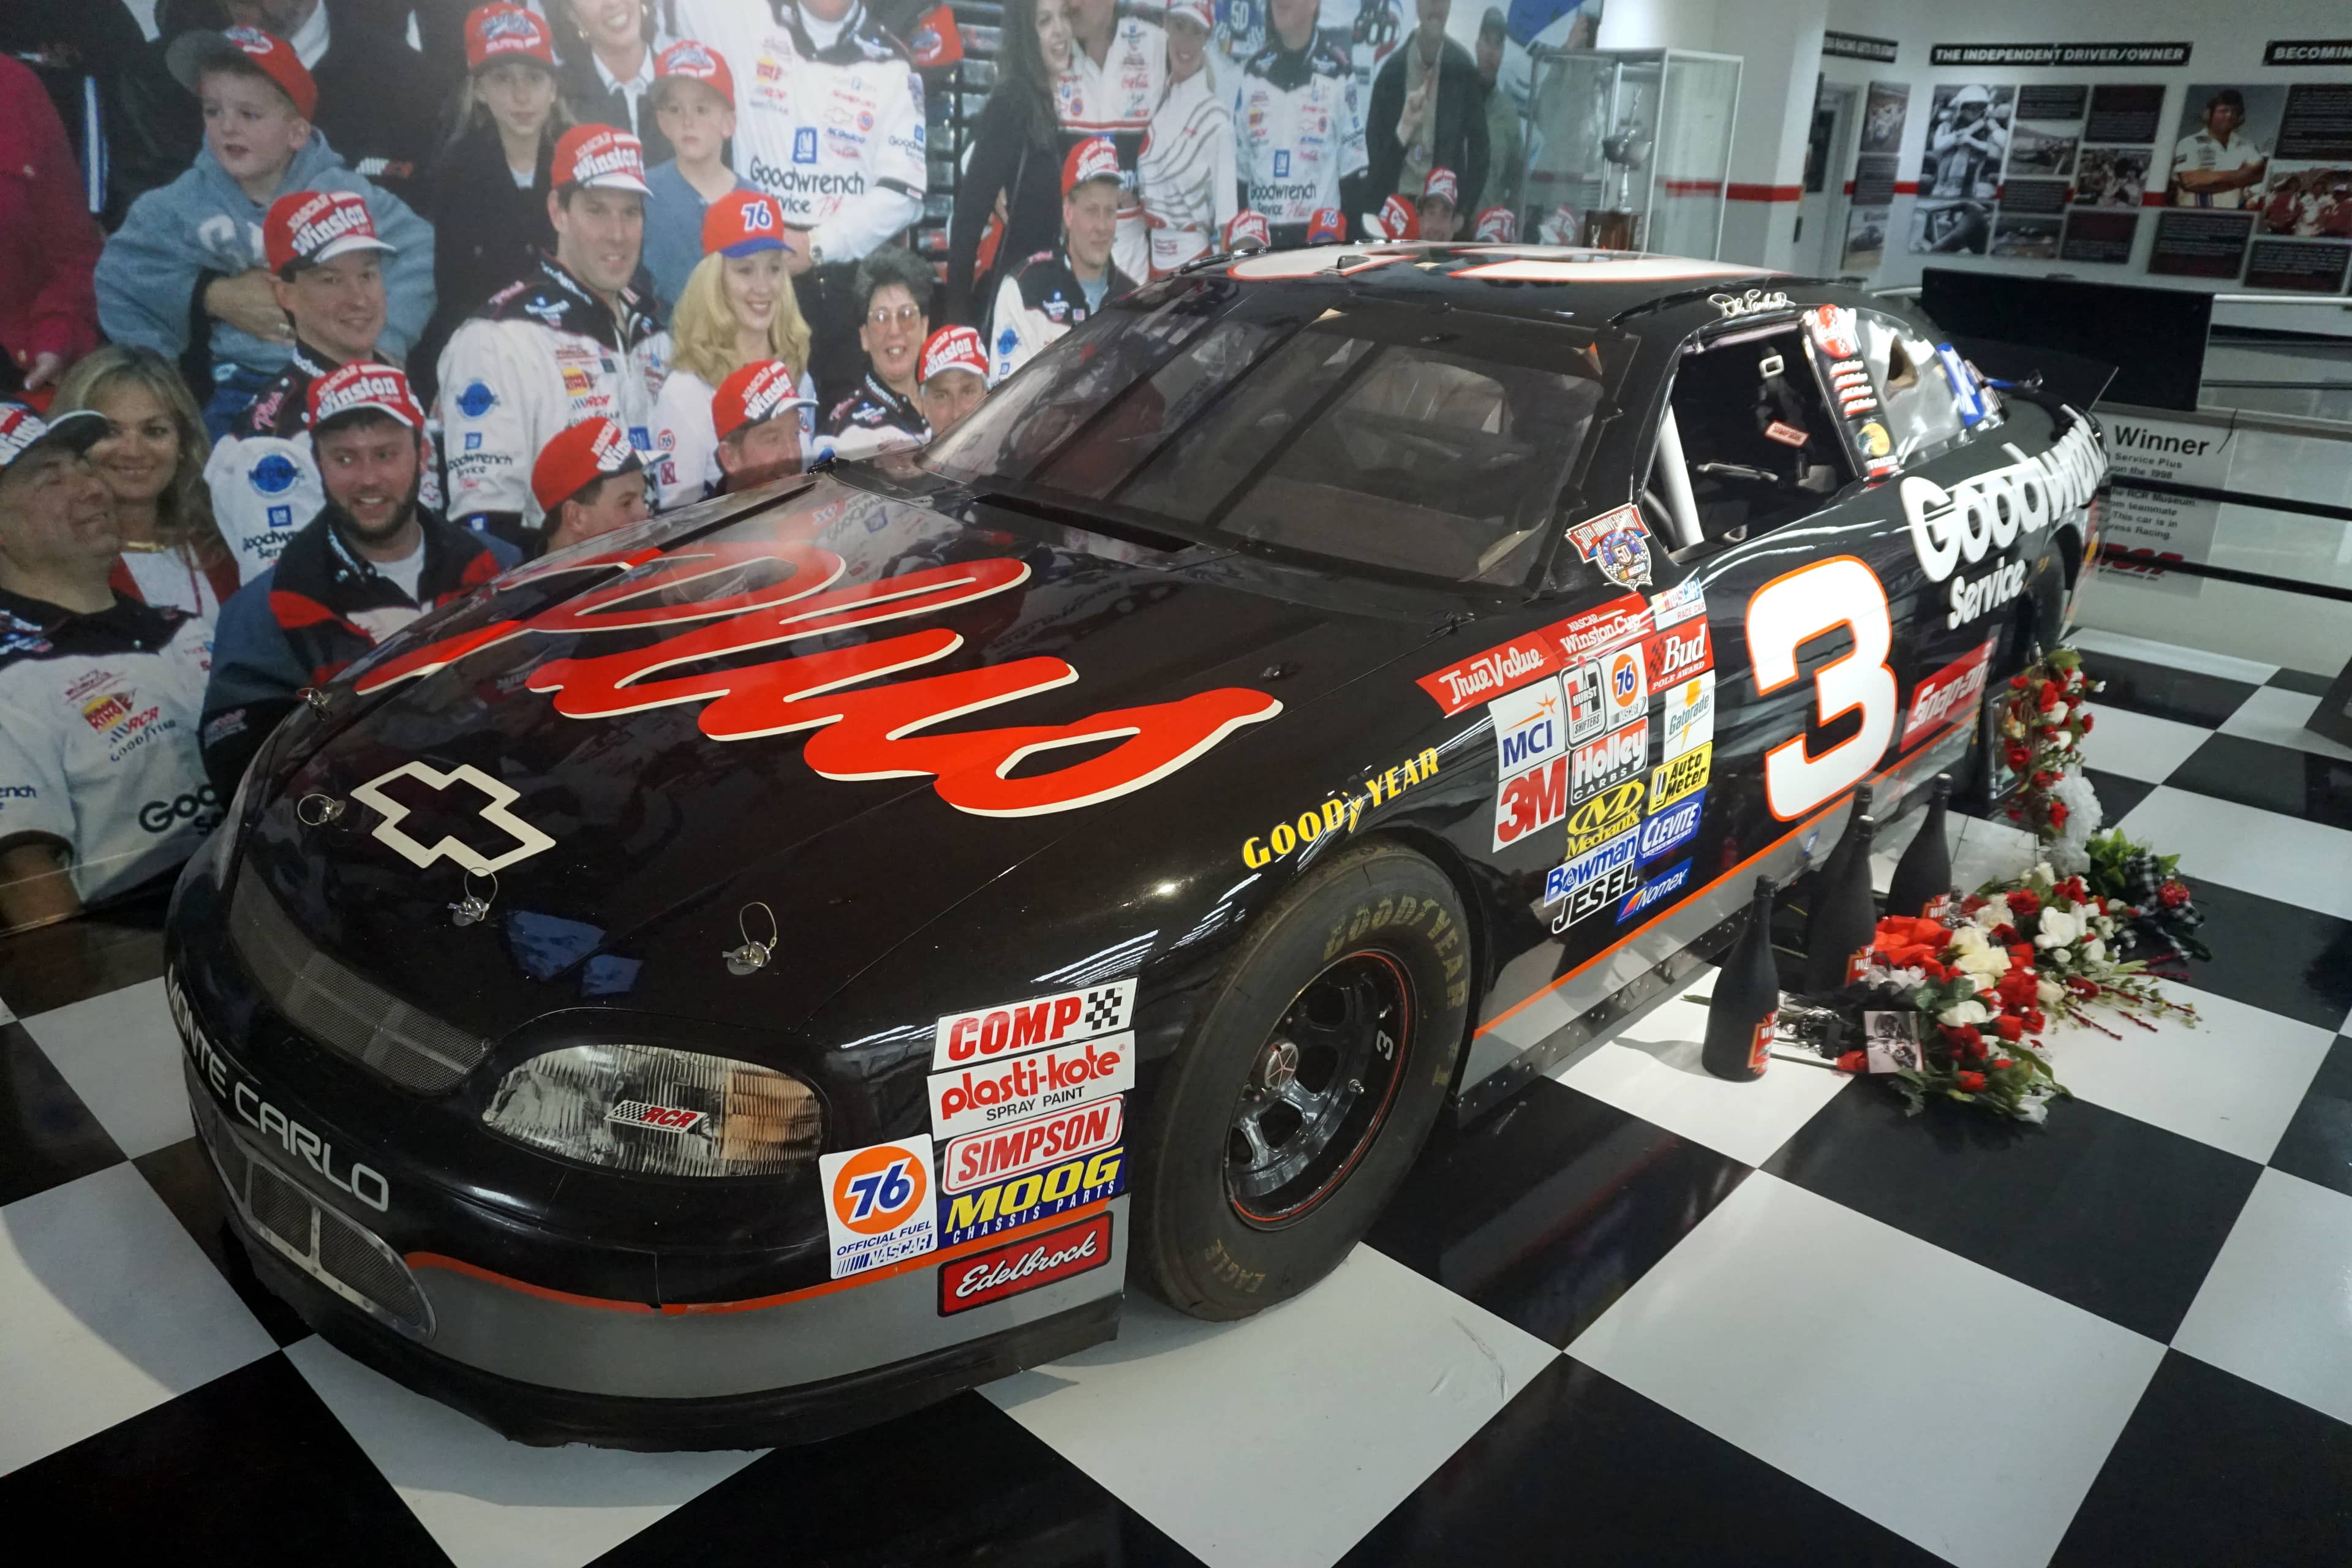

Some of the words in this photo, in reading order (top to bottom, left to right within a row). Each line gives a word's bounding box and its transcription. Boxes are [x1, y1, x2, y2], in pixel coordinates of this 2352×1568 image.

[1935, 49, 1961, 60] THE
[1962, 48, 2061, 61] INDEPENDENT
[2064, 48, 2185, 61] DRIVER/OWNER
[573, 146, 638, 181] Winston
[750, 154, 864, 195] Goodwrench
[291, 204, 367, 256] Winston
[742, 200, 772, 230] 76
[1321, 211, 1338, 227] 76
[925, 331, 949, 358] NASCAR
[925, 337, 973, 377] Winston
[317, 376, 399, 420] Winston
[742, 367, 771, 404] NASCAR
[1772, 424, 1802, 442] SIMPSON
[2116, 425, 2210, 456] Winner
[2115, 452, 2154, 466] Service
[2158, 458, 2182, 469] Plus
[2130, 466, 2146, 476] the
[2151, 469, 2173, 479] 1998
[2127, 489, 2149, 499] RCR
[2152, 491, 2195, 507] Museum
[2128, 502, 2177, 516] teammate
[1574, 524, 1593, 549] 50TH
[1592, 508, 1638, 536] ANNIVERSARY
[2113, 511, 2133, 521] This
[2136, 515, 2152, 524] car
[2156, 516, 2165, 526] is
[2169, 519, 2178, 529] in
[1615, 546, 1632, 562] 50
[1678, 609, 1692, 620] RACE
[1694, 601, 1705, 613] CAR
[1947, 556, 2026, 631] Service
[1559, 622, 1615, 655] Winston
[1613, 614, 1641, 635] Cup
[1567, 614, 1600, 633] NASCAR
[1662, 623, 1706, 675] Bud
[1439, 671, 1493, 705] True
[1471, 646, 1544, 687] Value
[1616, 661, 1634, 698] 76
[1653, 674, 1675, 690] POLE
[1676, 661, 1705, 680] AWARD
[1744, 554, 1898, 822] 3
[1573, 687, 1597, 706] HURST
[1669, 694, 1709, 735] Gatorade
[1907, 659, 1991, 734] Snap-on
[127, 706, 159, 733] RCR
[1575, 715, 1600, 734] SHIFTERS
[1502, 718, 1553, 768] MCI
[1574, 731, 1645, 789] Holley
[1574, 767, 1627, 800] CARBS
[1667, 767, 1707, 799] Meter
[1670, 752, 1703, 782] Auto
[1243, 747, 1439, 870] GOODYEAR
[1498, 756, 1567, 843] 3M
[1642, 802, 1700, 853] CLEVITE
[1548, 835, 1637, 902] Bowman
[1553, 861, 1638, 933] JESEL
[1637, 869, 1686, 907] Nomex
[948, 996, 1082, 1061] COMP
[167, 962, 227, 1098] MONTE
[235, 1081, 389, 1212] CARLO
[941, 1044, 1120, 1120] plasti-kote
[641, 1106, 698, 1128] RCR
[986, 1098, 1035, 1121] SPRAY
[1042, 1087, 1085, 1108] PAINT
[957, 1106, 1111, 1182] SIMPSON
[848, 1159, 913, 1221] 76
[945, 1147, 1124, 1234] MOOG
[952, 1205, 1040, 1245] CHASSIS
[1056, 1180, 1115, 1213] PARTS
[837, 1231, 897, 1256] OFFICIAL
[899, 1221, 932, 1238] FUEL
[870, 1233, 933, 1265] NASCAR
[956, 1230, 1099, 1298] Edelbrock
